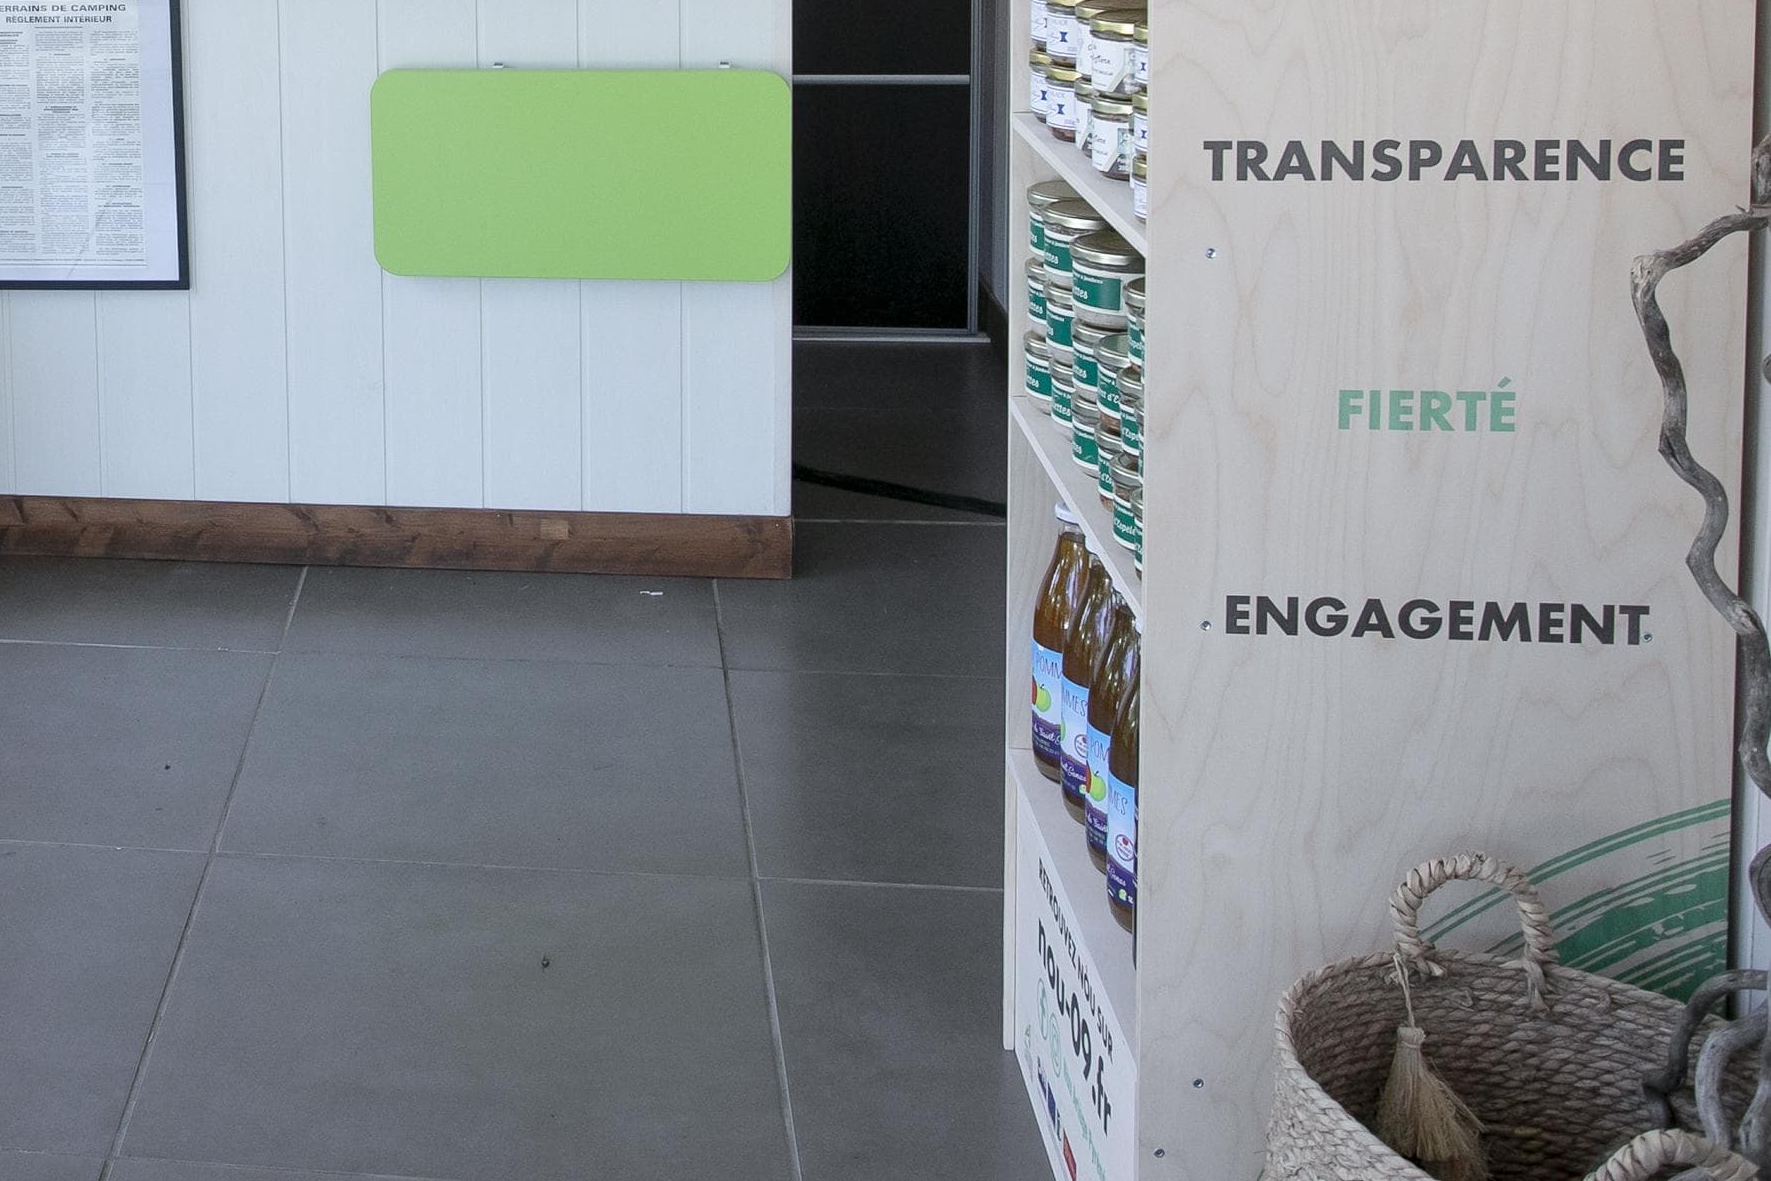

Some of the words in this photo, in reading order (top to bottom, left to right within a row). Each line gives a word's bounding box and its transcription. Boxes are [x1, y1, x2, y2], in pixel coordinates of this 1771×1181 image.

[51, 4, 67, 12] DE
[70, 3, 126, 12] CAMPING
[1203, 138, 1685, 182] TRANSPARENCE
[1338, 376, 1517, 432] FIERTÉ
[1225, 595, 1650, 646] ENGAGEMENT
[1038, 856, 1077, 969] RETROUVEZ
[1096, 1009, 1114, 1065] SUR
[1037, 917, 1112, 1137] nou-09.fr
